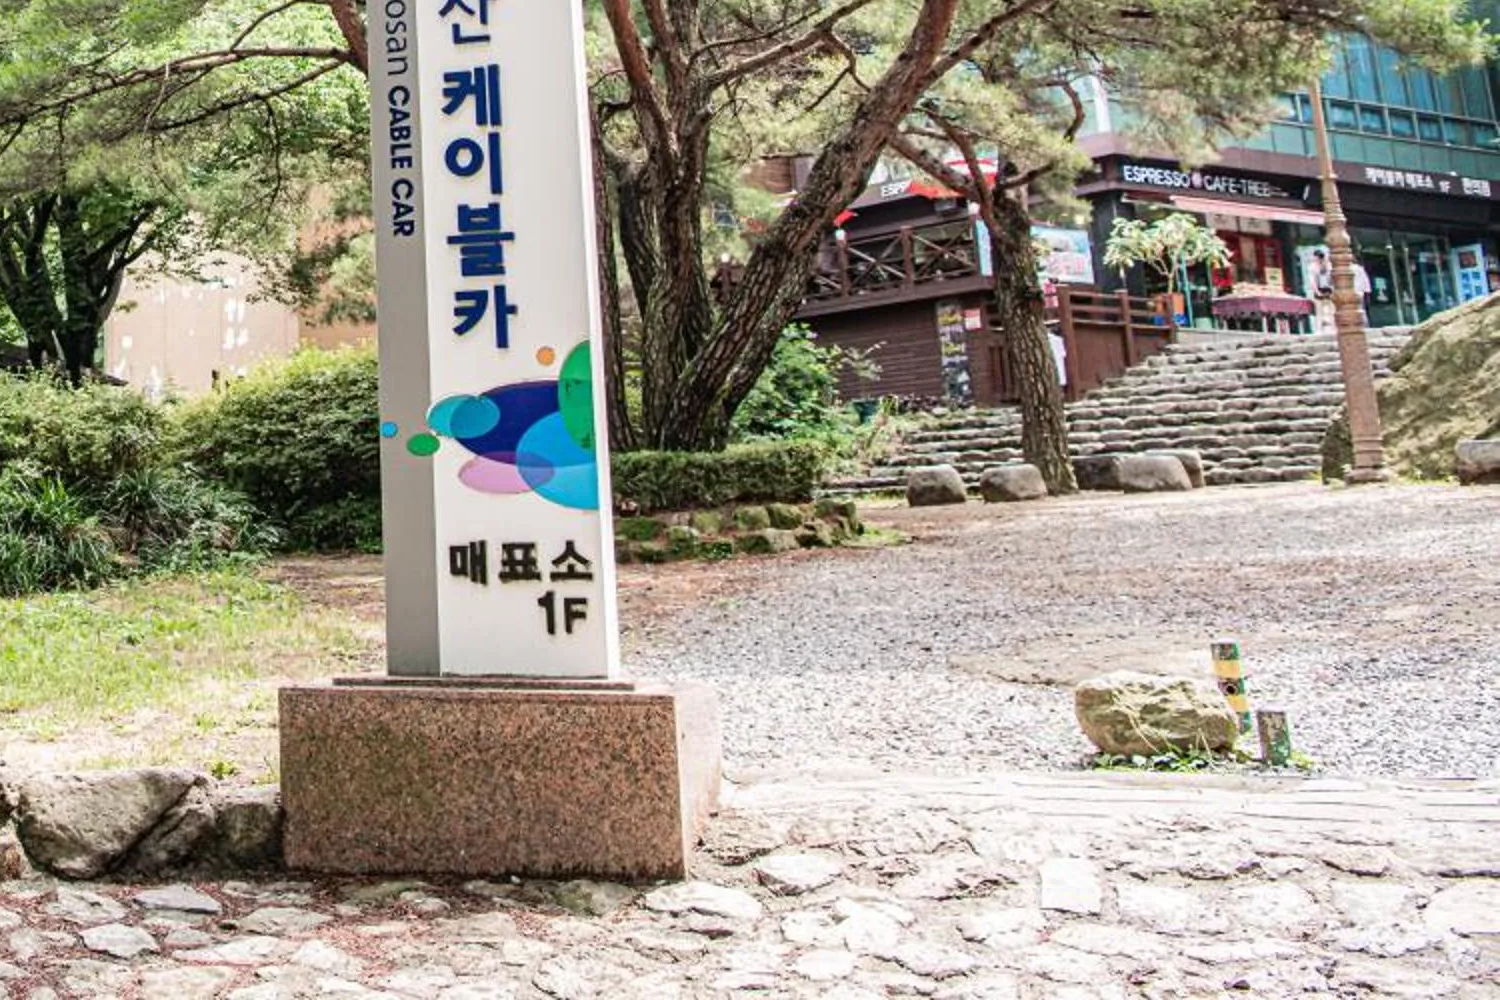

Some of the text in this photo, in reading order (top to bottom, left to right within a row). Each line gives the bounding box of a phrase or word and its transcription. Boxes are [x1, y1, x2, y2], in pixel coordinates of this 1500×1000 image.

[387, 85, 413, 170] CABLE
[1123, 165, 1190, 188] ESPRESSO
[391, 178, 415, 238] CAR
[440, 62, 518, 350] 케이블카
[449, 540, 593, 586] 매표소
[537, 590, 588, 636] 1F
